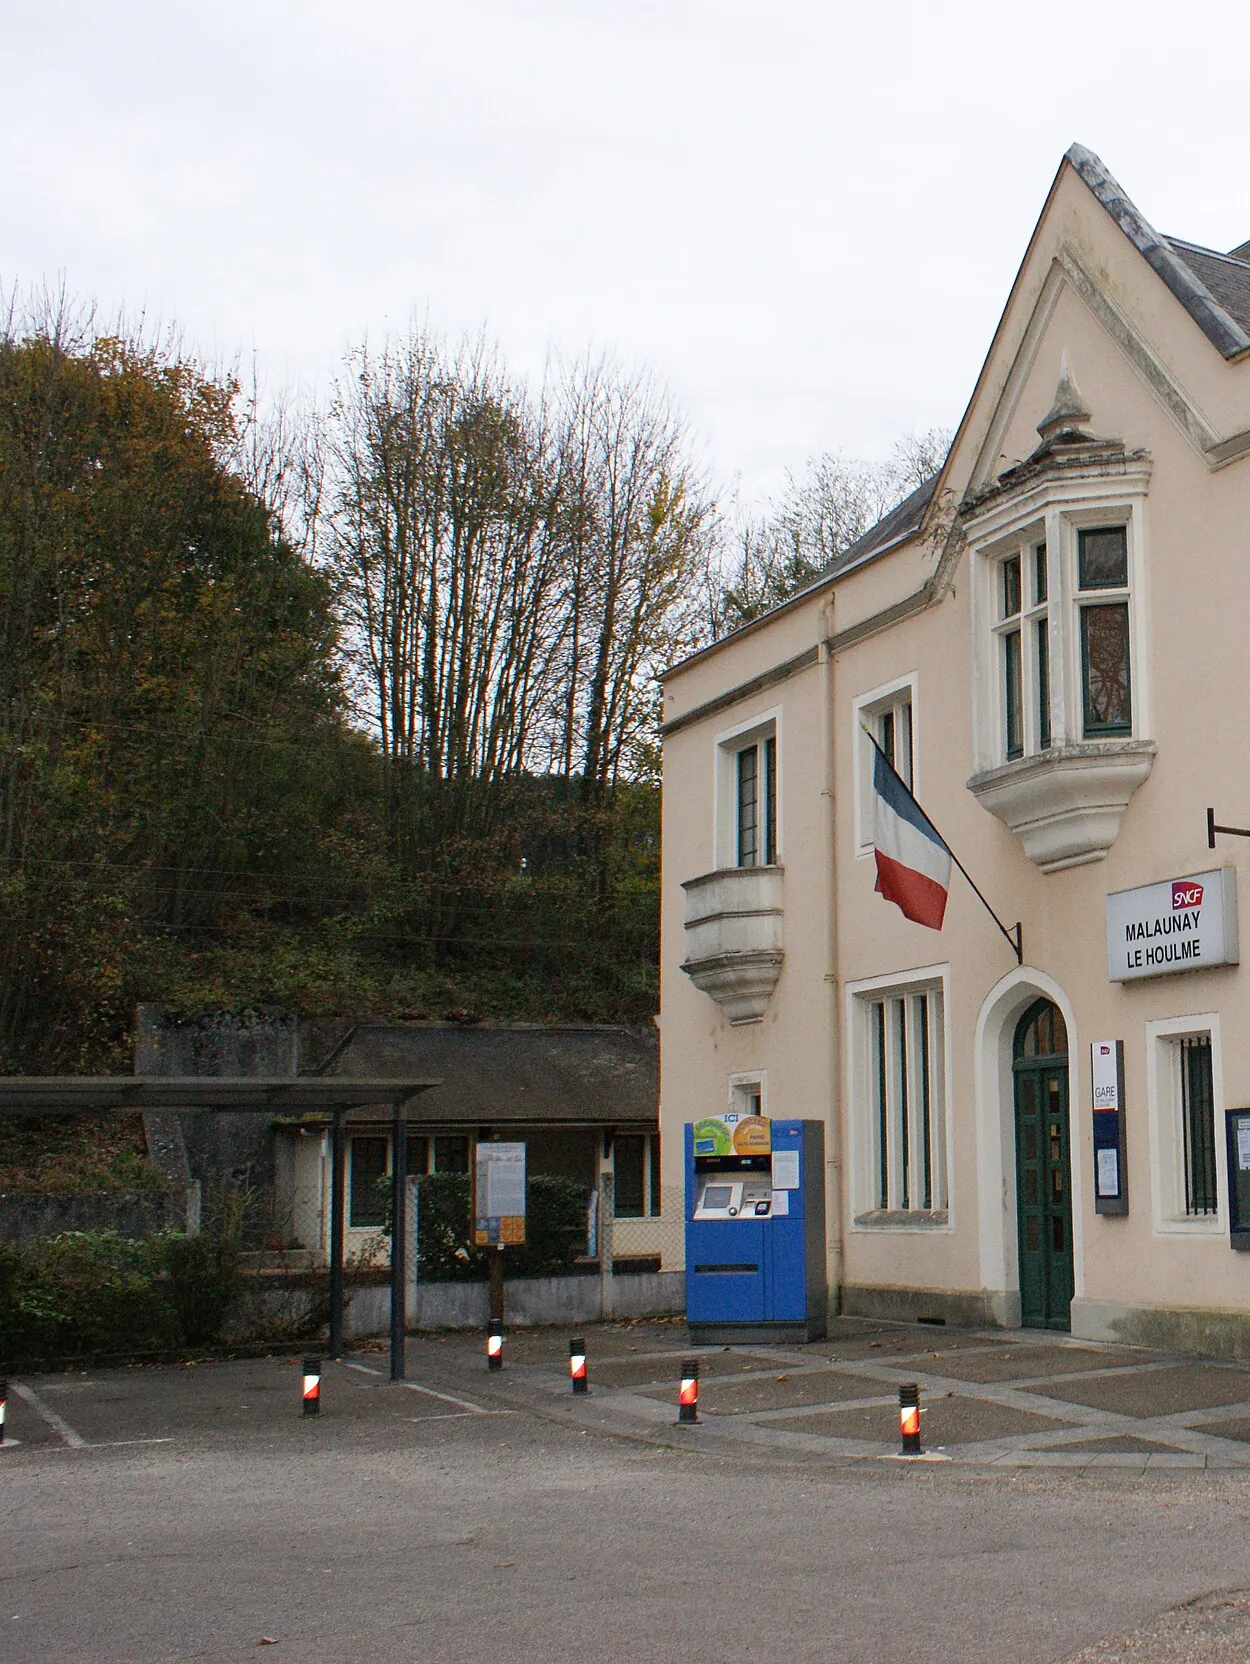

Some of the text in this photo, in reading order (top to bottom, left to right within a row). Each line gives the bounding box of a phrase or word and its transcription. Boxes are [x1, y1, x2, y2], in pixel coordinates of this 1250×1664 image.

[1173, 888, 1202, 906] SNCF
[1125, 911, 1201, 941] MALAUNAY
[1127, 939, 1201, 968] LE HOULME
[1095, 1086, 1115, 1098] GARE
[724, 1114, 739, 1123] ICI
